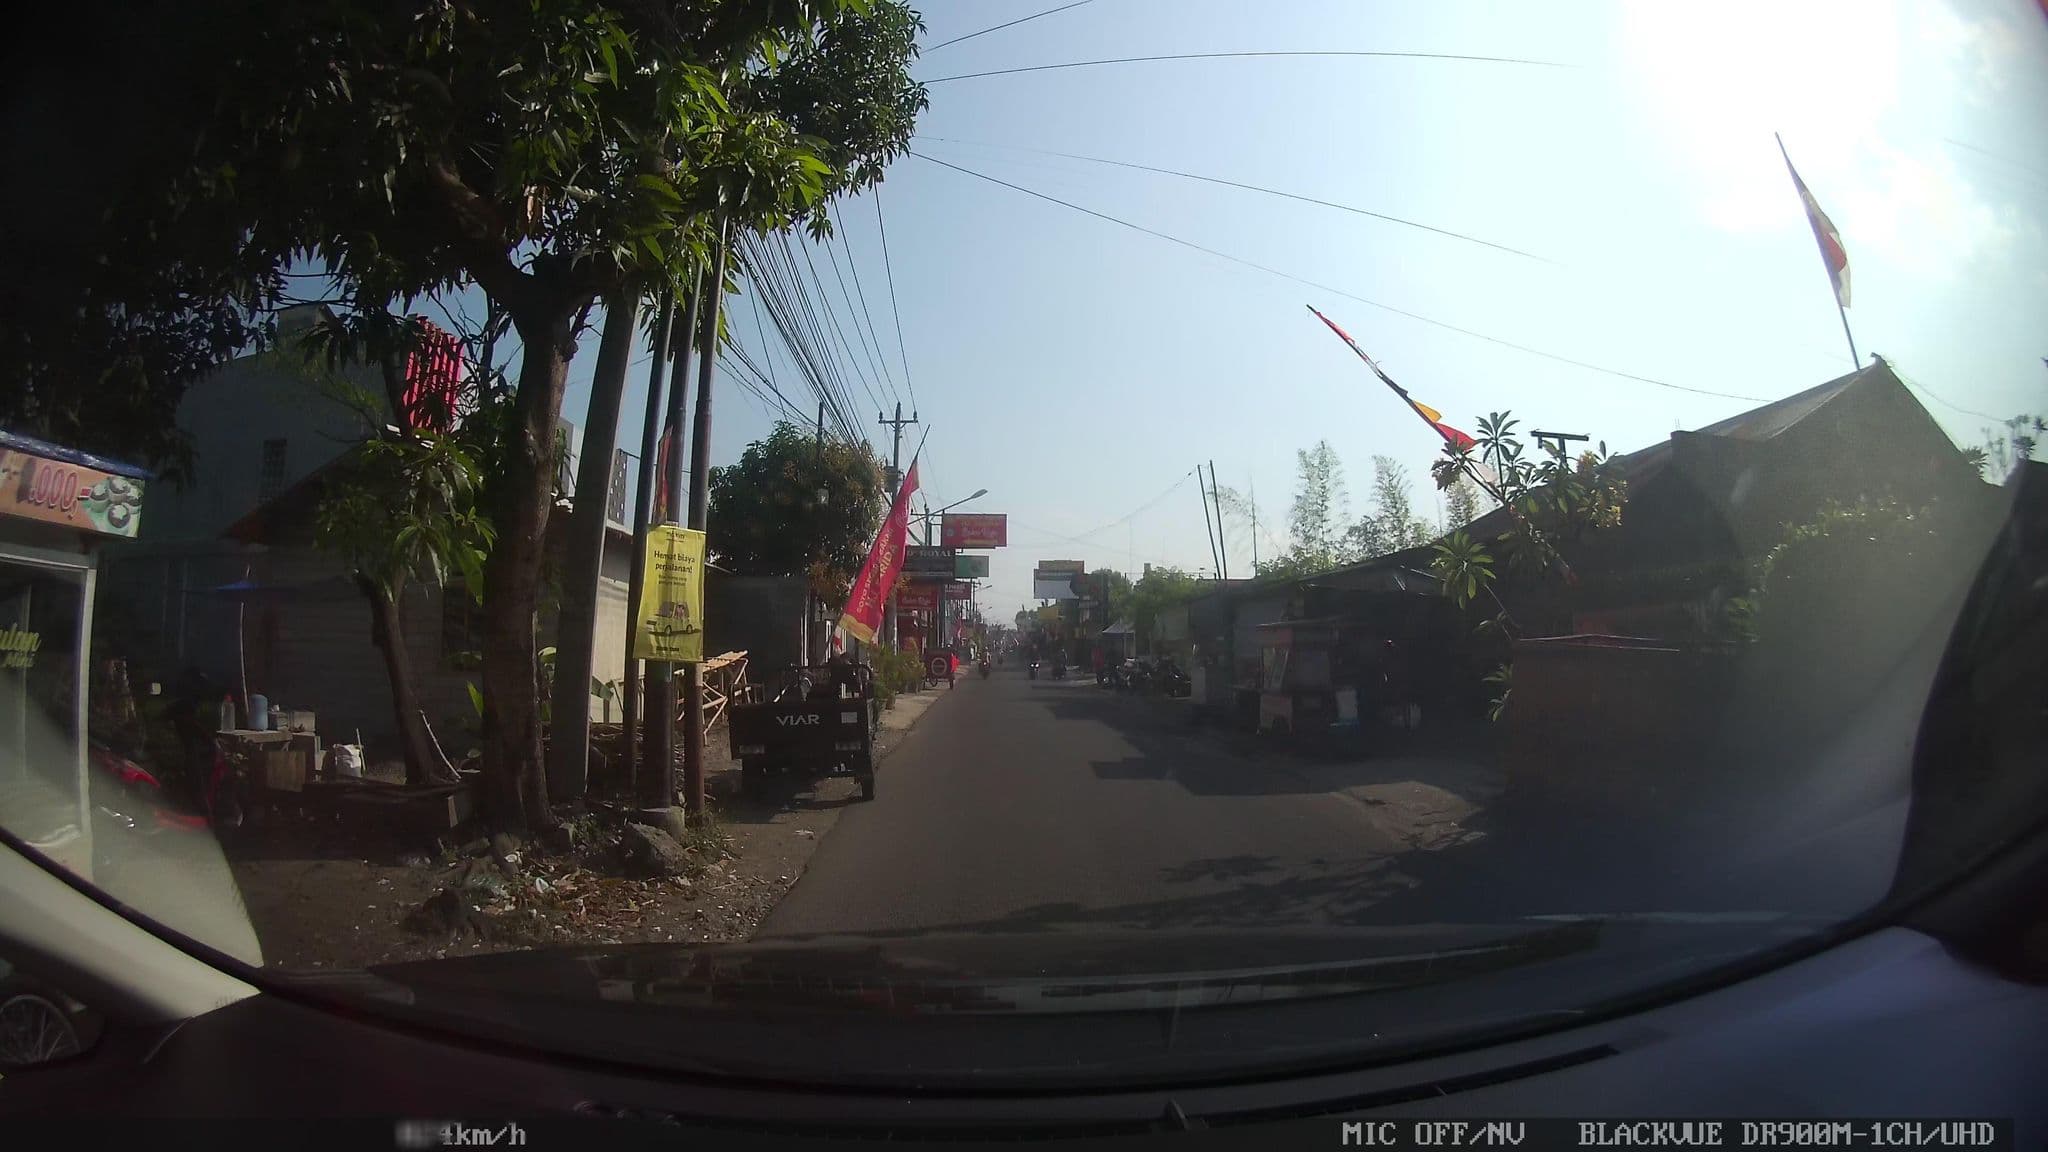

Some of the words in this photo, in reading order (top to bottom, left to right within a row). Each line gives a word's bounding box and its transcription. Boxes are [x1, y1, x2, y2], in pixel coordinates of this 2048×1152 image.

[654, 550, 676, 561] Hemat
[677, 553, 695, 564] biaya
[776, 715, 820, 726] VIAR
